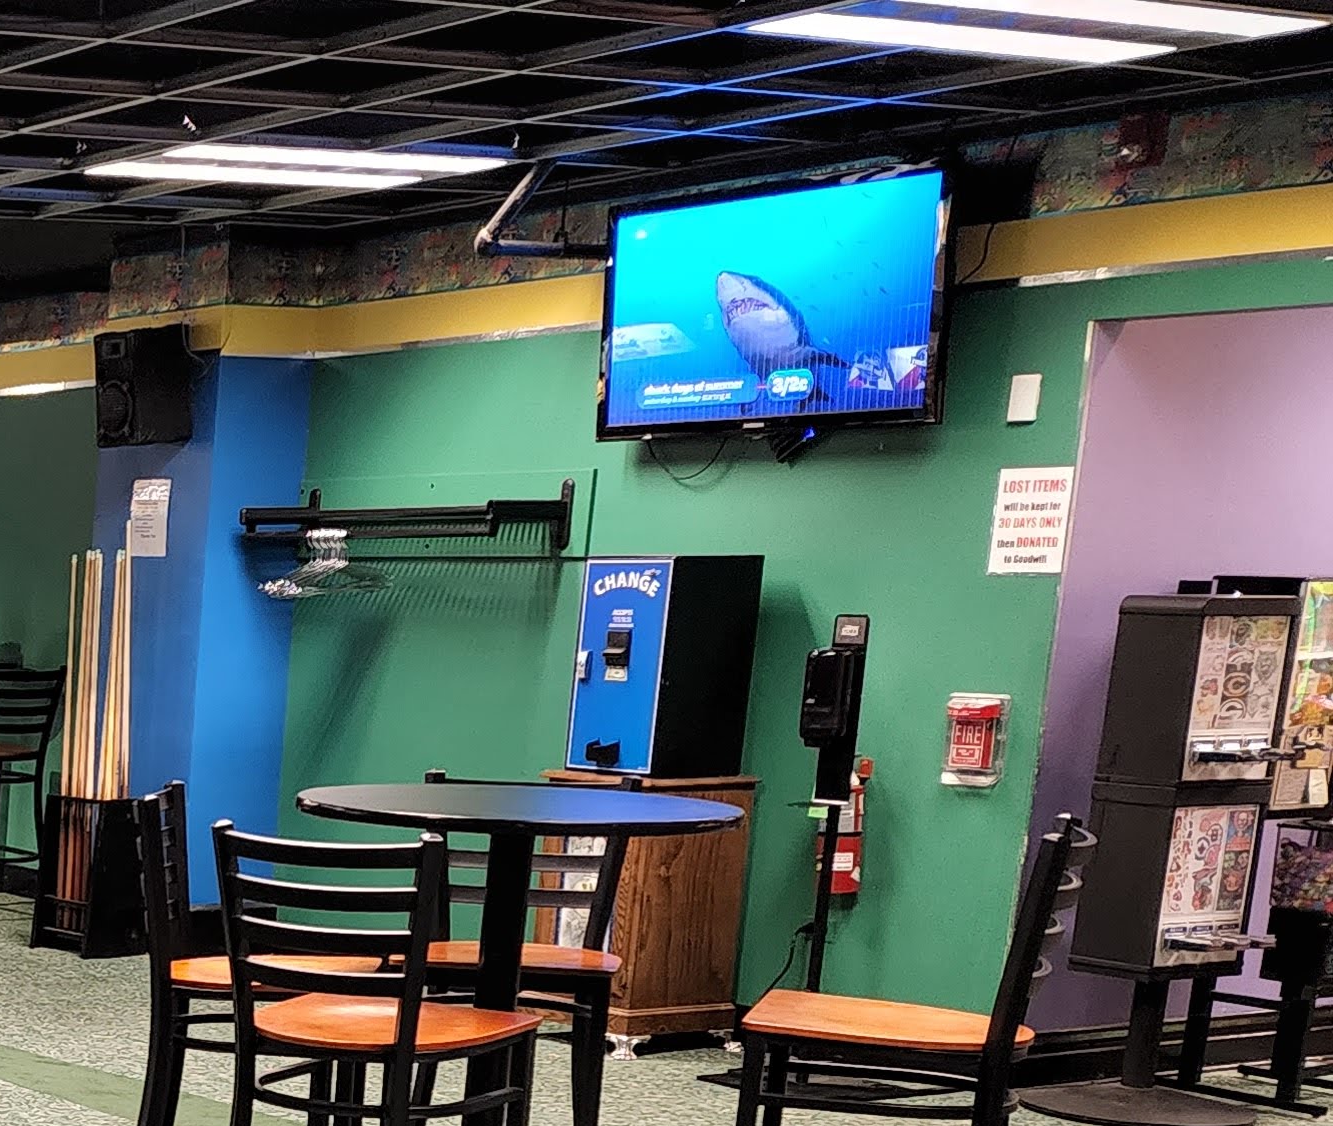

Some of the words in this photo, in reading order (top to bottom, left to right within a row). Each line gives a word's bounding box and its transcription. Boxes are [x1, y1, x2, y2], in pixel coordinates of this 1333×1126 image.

[1003, 480, 1030, 493] LOST
[1033, 479, 1067, 492] ITEMS
[1004, 503, 1018, 511] will
[1020, 503, 1029, 511] be
[1031, 503, 1048, 512] kept
[1049, 502, 1061, 511] for
[998, 518, 1011, 528] 30
[1013, 517, 1037, 528] DAYS
[1039, 517, 1063, 528] ONLY
[997, 540, 1014, 549] then
[1016, 537, 1058, 548] DONATED
[1004, 555, 1011, 563] to
[1013, 555, 1047, 564] Goodwill
[593, 571, 661, 598] CHANGE
[954, 725, 982, 744] FIRE
